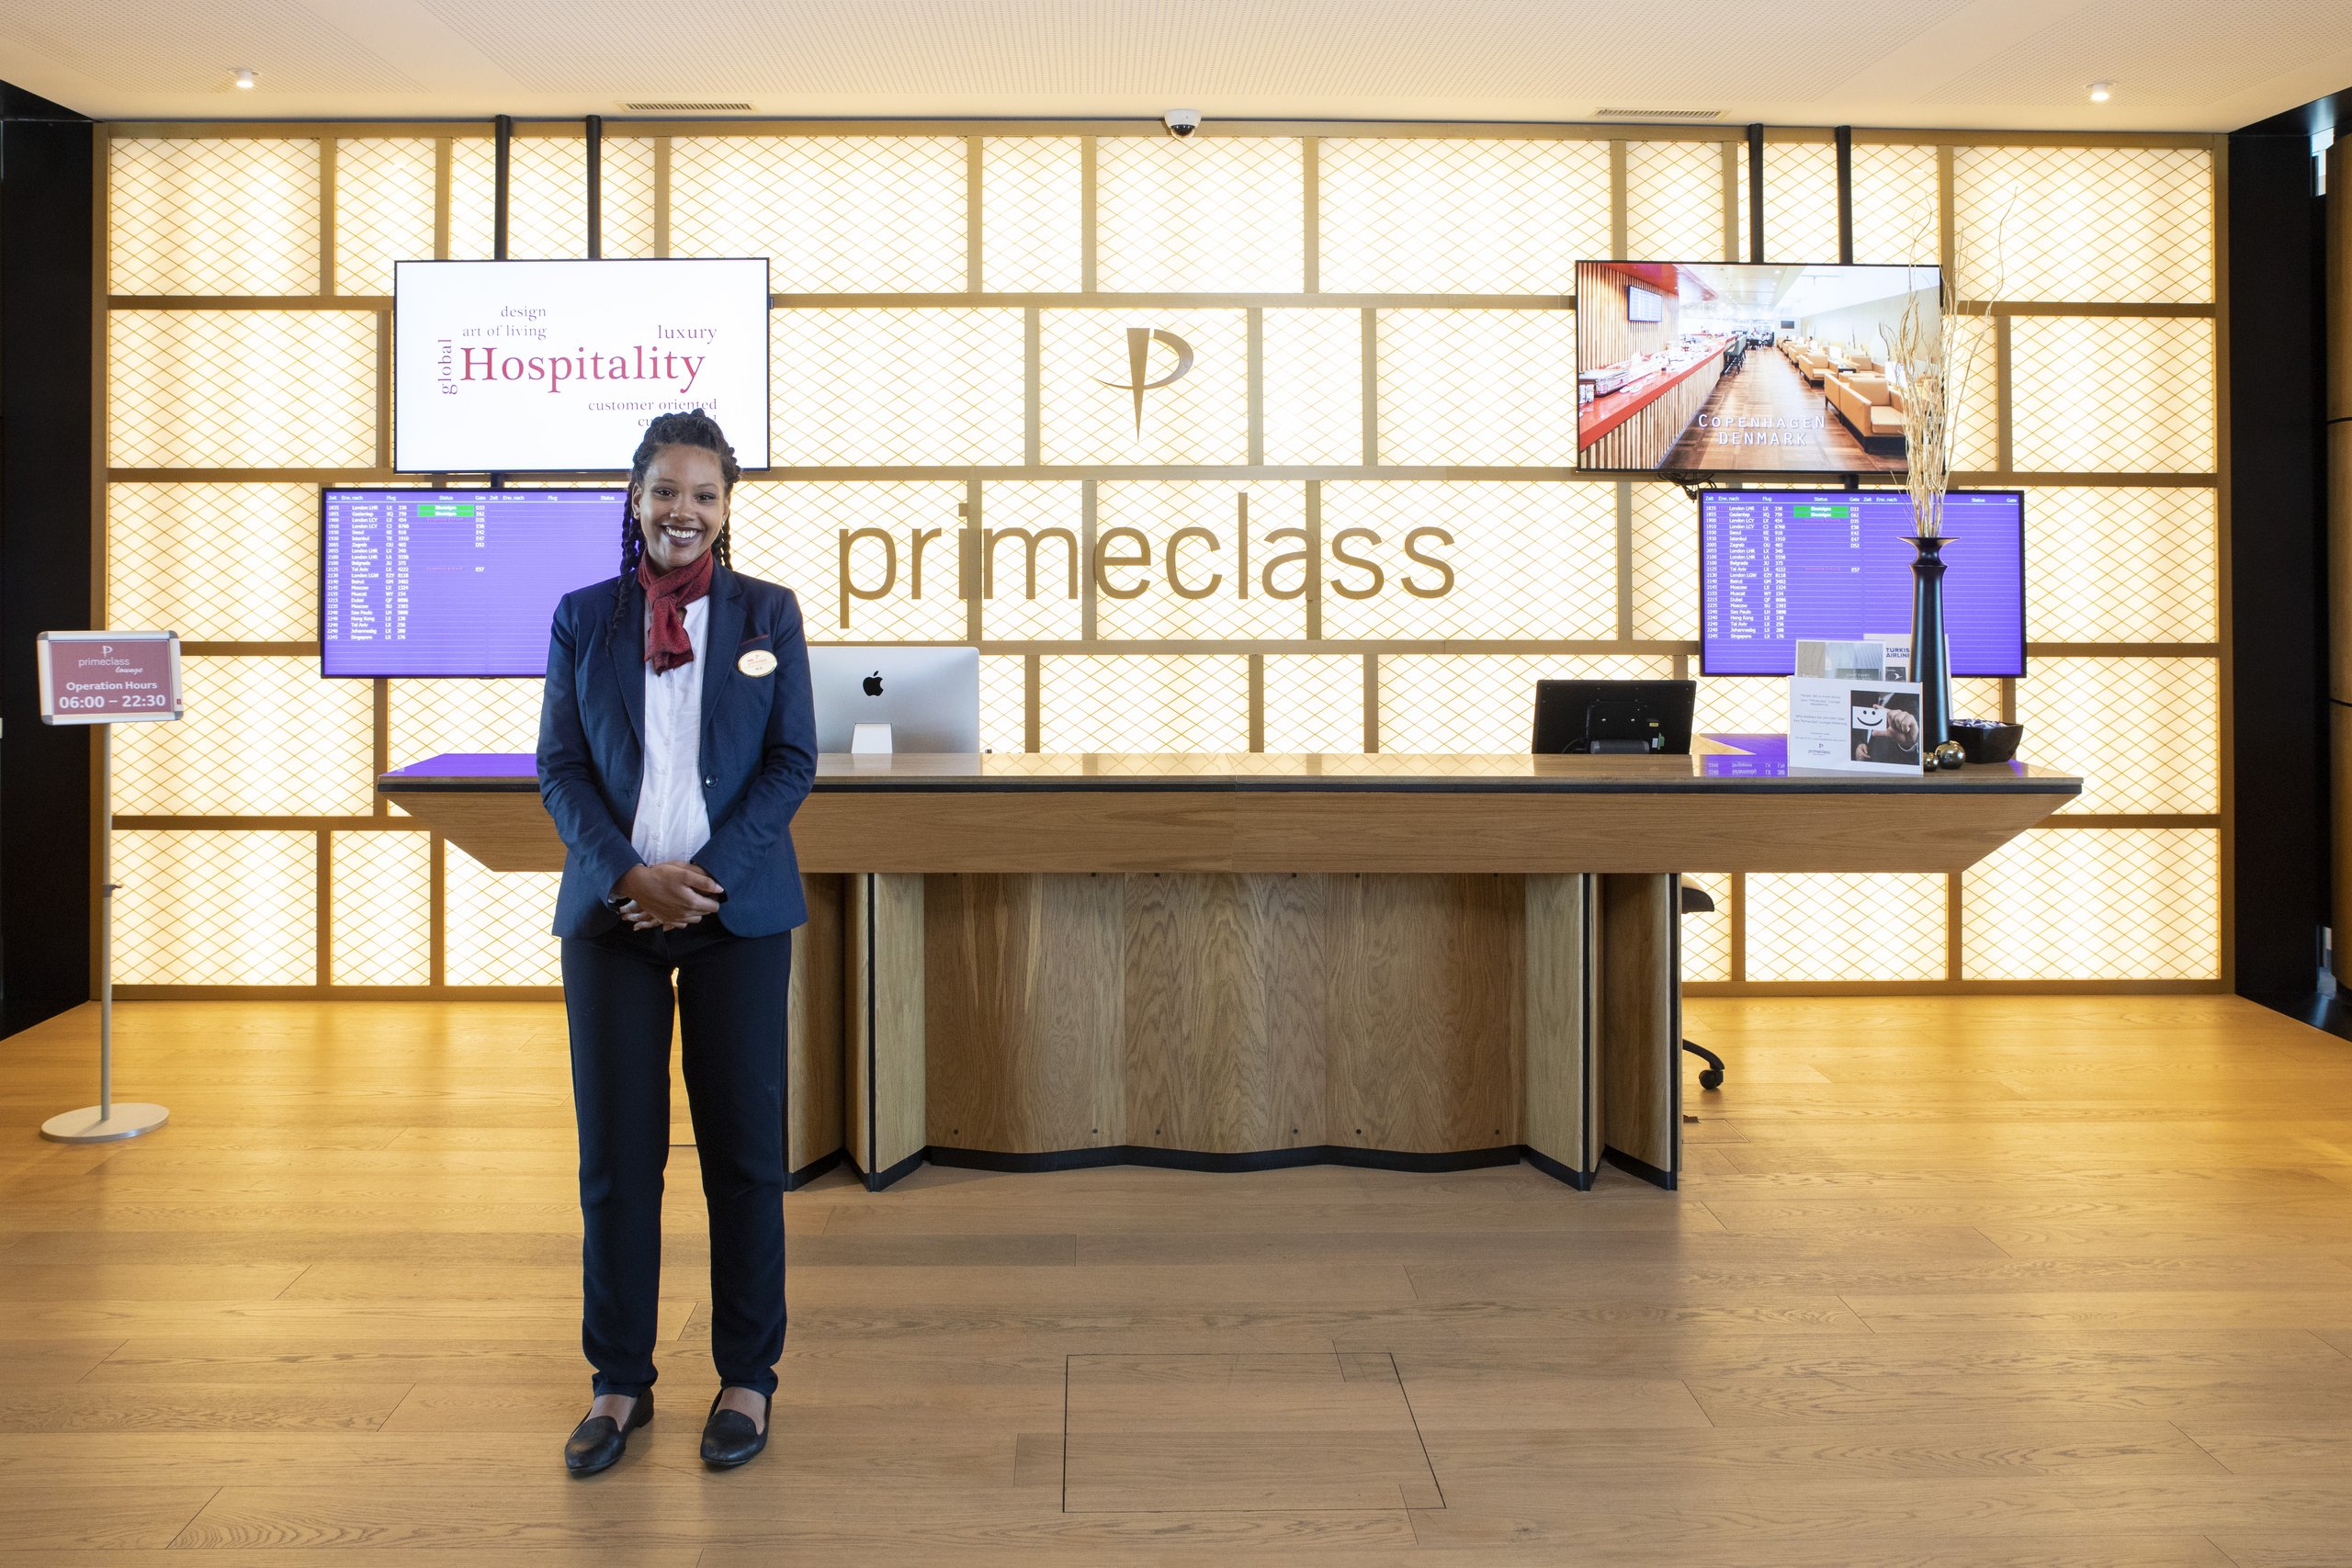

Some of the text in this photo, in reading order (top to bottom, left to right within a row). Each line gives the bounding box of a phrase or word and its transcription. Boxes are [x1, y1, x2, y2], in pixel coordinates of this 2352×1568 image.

[501, 306, 547, 321] design
[462, 325, 548, 341] art of living
[658, 325, 718, 344] luxury
[437, 339, 458, 395] global
[460, 345, 706, 394] Hospitality
[588, 399, 718, 411] customer oriented
[1718, 433, 1806, 445] DENMARK
[839, 492, 1455, 629] primeclass
[78, 657, 130, 669] primeclass
[115, 666, 143, 675] lounge
[66, 682, 158, 693] Operation Hours
[59, 696, 105, 708] 06:00
[121, 694, 166, 707] 22:30
